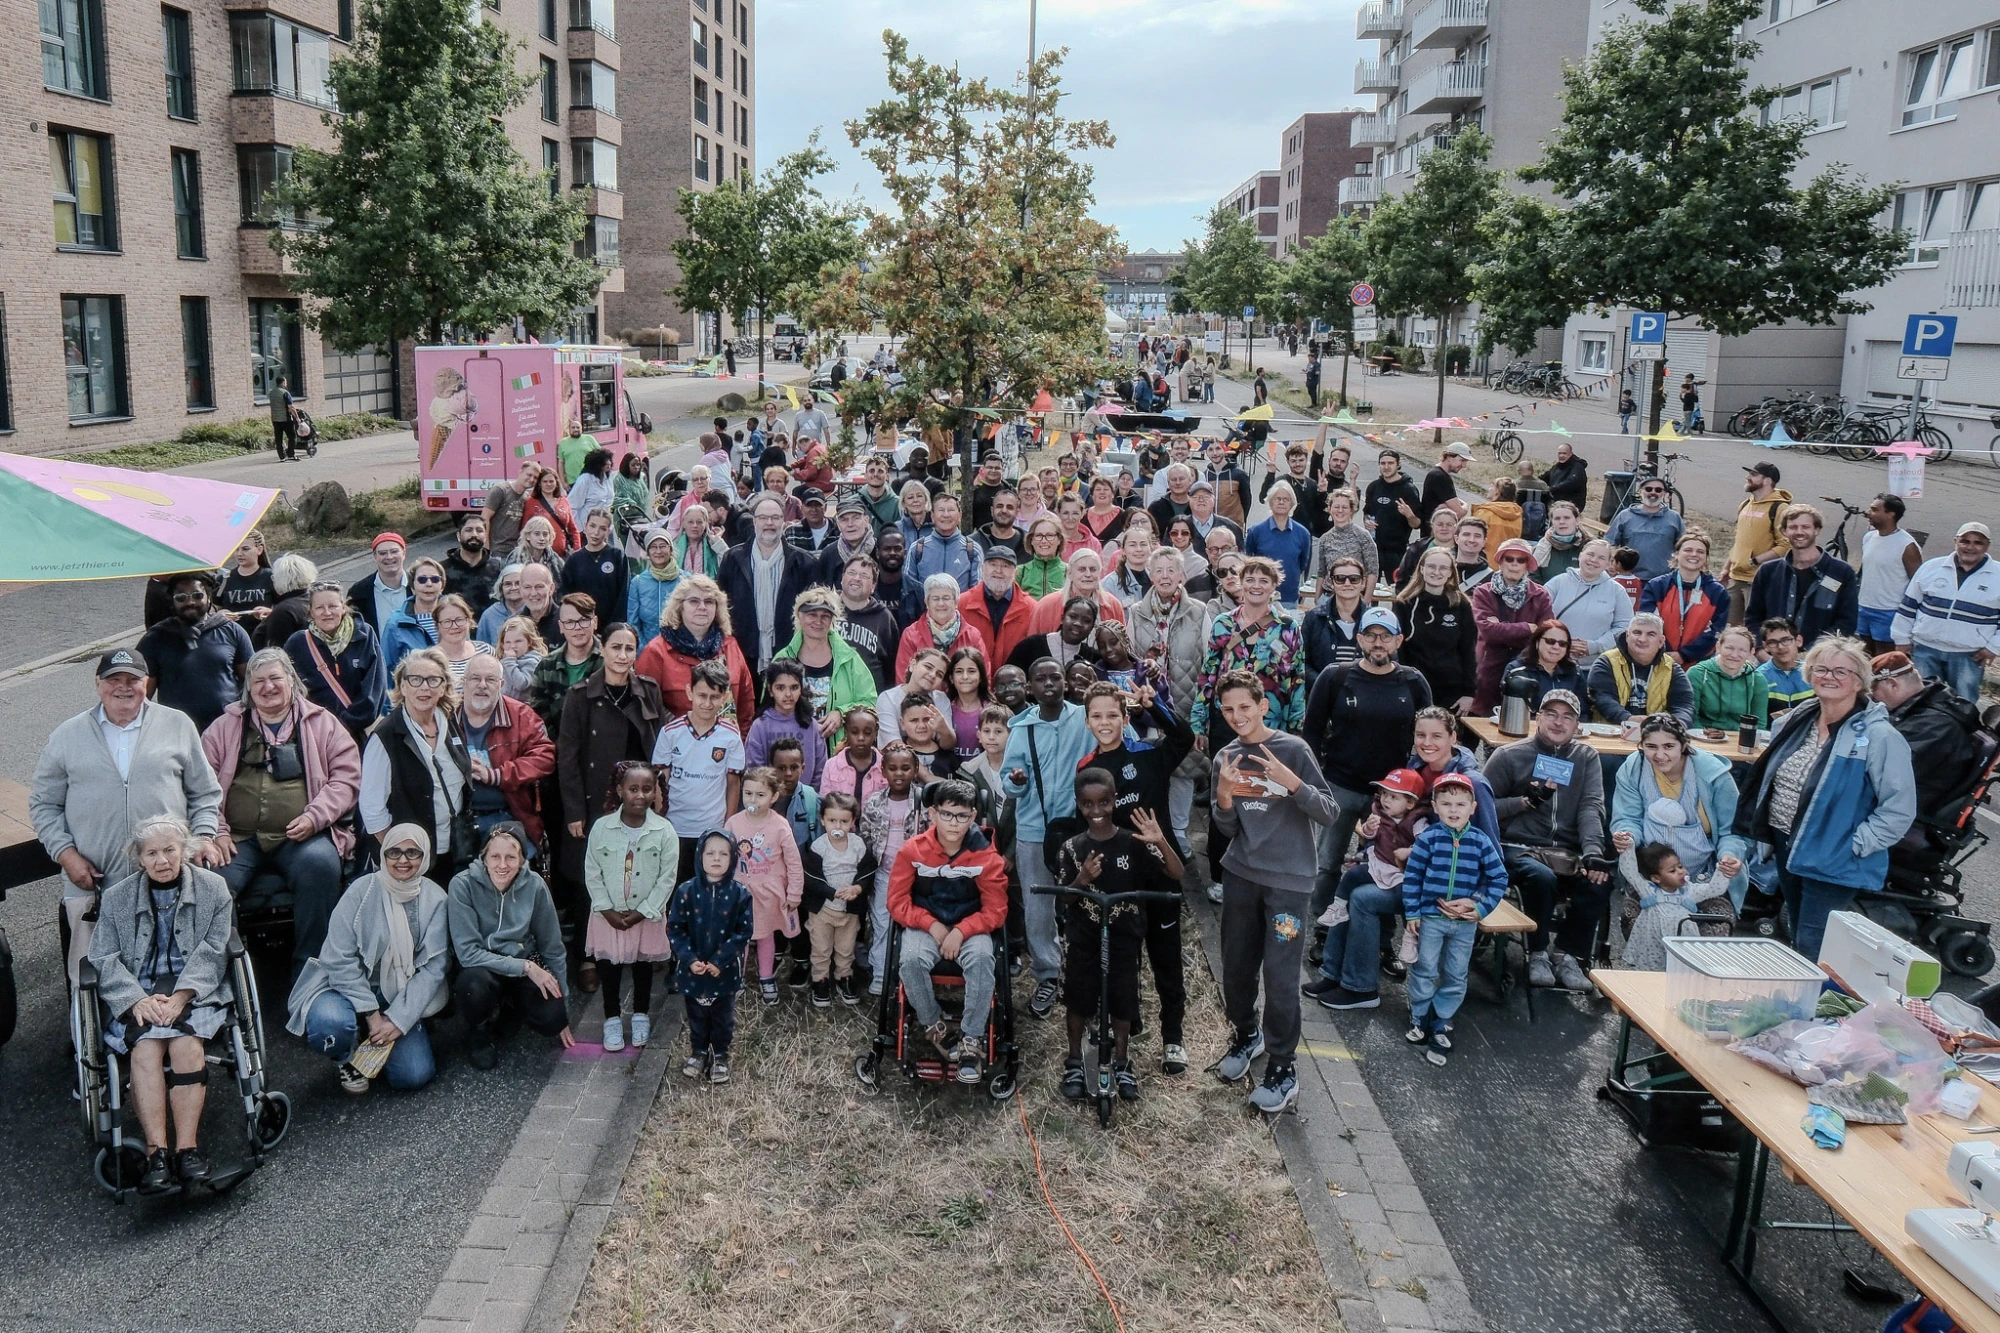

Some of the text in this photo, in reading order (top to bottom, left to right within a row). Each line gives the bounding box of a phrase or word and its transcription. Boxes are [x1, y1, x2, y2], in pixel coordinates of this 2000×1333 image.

[1638, 316, 1657, 339] P
[1914, 319, 1944, 351] P
[30, 561, 125, 572] www.jetzthier.eu
[227, 588, 266, 604] VLTN
